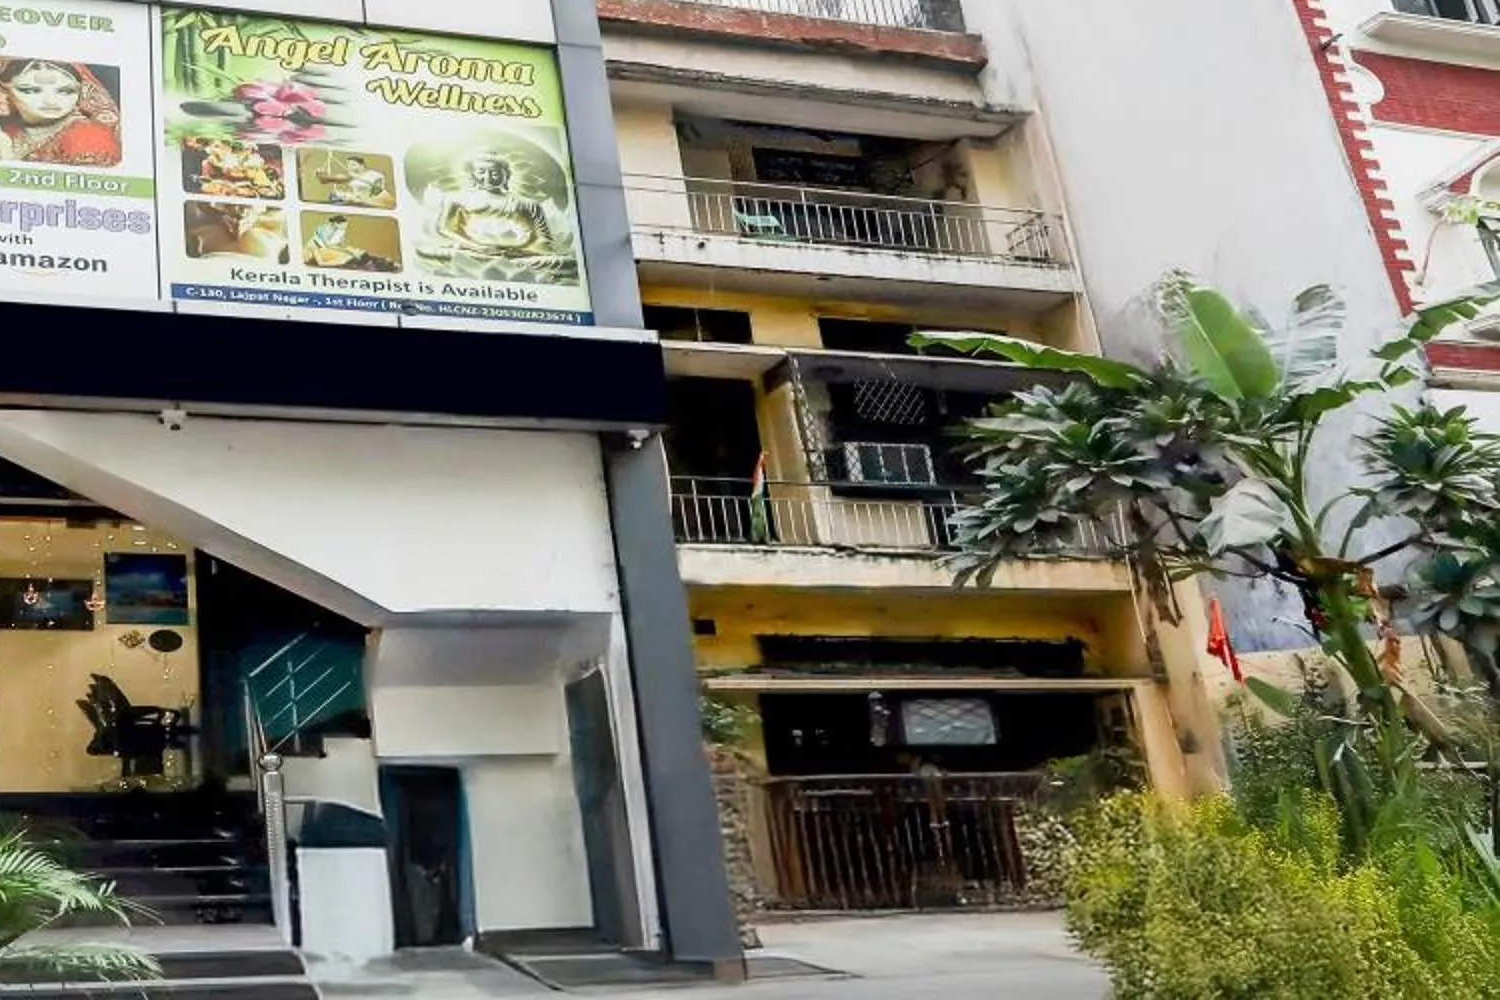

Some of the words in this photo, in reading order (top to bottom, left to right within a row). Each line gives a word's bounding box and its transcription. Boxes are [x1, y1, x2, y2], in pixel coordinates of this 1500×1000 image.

[201, 25, 348, 69] Angel
[359, 43, 534, 87] Aroma
[368, 77, 542, 119] Wellness
[8, 169, 56, 187] 2nd
[65, 174, 130, 193] Floor
[230, 267, 301, 286] Kerala
[307, 273, 412, 293] Therapist
[419, 281, 434, 295] is
[441, 283, 539, 302] Available
